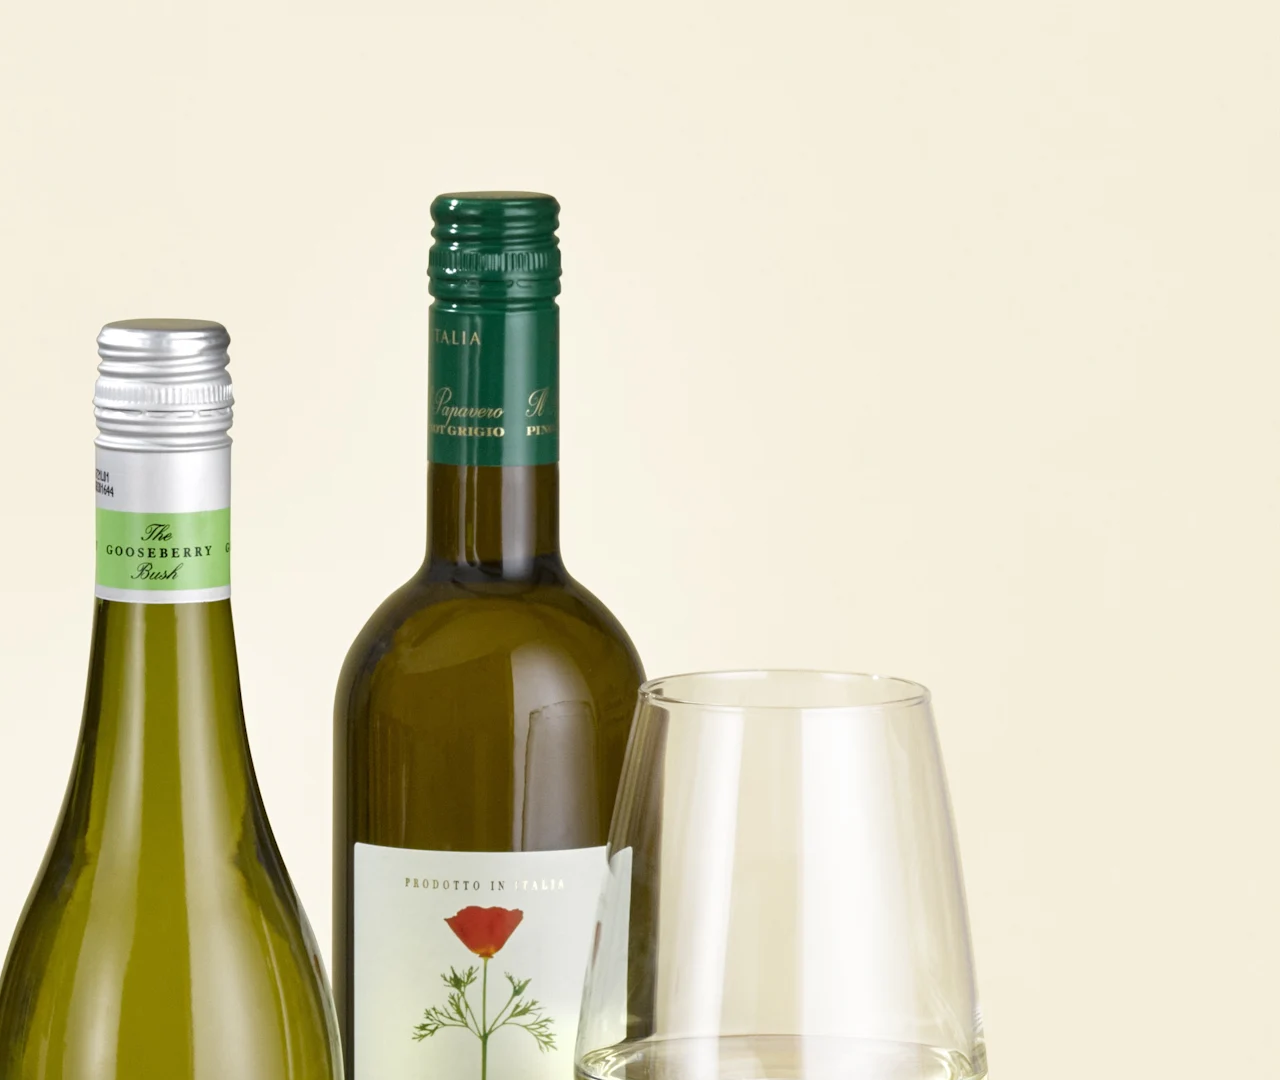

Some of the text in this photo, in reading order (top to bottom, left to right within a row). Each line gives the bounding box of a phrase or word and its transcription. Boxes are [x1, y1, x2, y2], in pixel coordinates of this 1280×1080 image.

[434, 328, 481, 345] TALIA
[435, 387, 504, 427] Papavero
[447, 425, 505, 437] GRIGIO
[140, 523, 173, 542] The
[106, 545, 212, 559] GOOSEBERRY
[130, 562, 184, 581] Bush
[404, 877, 481, 891] PRODOTTO
[490, 880, 505, 891] IN
